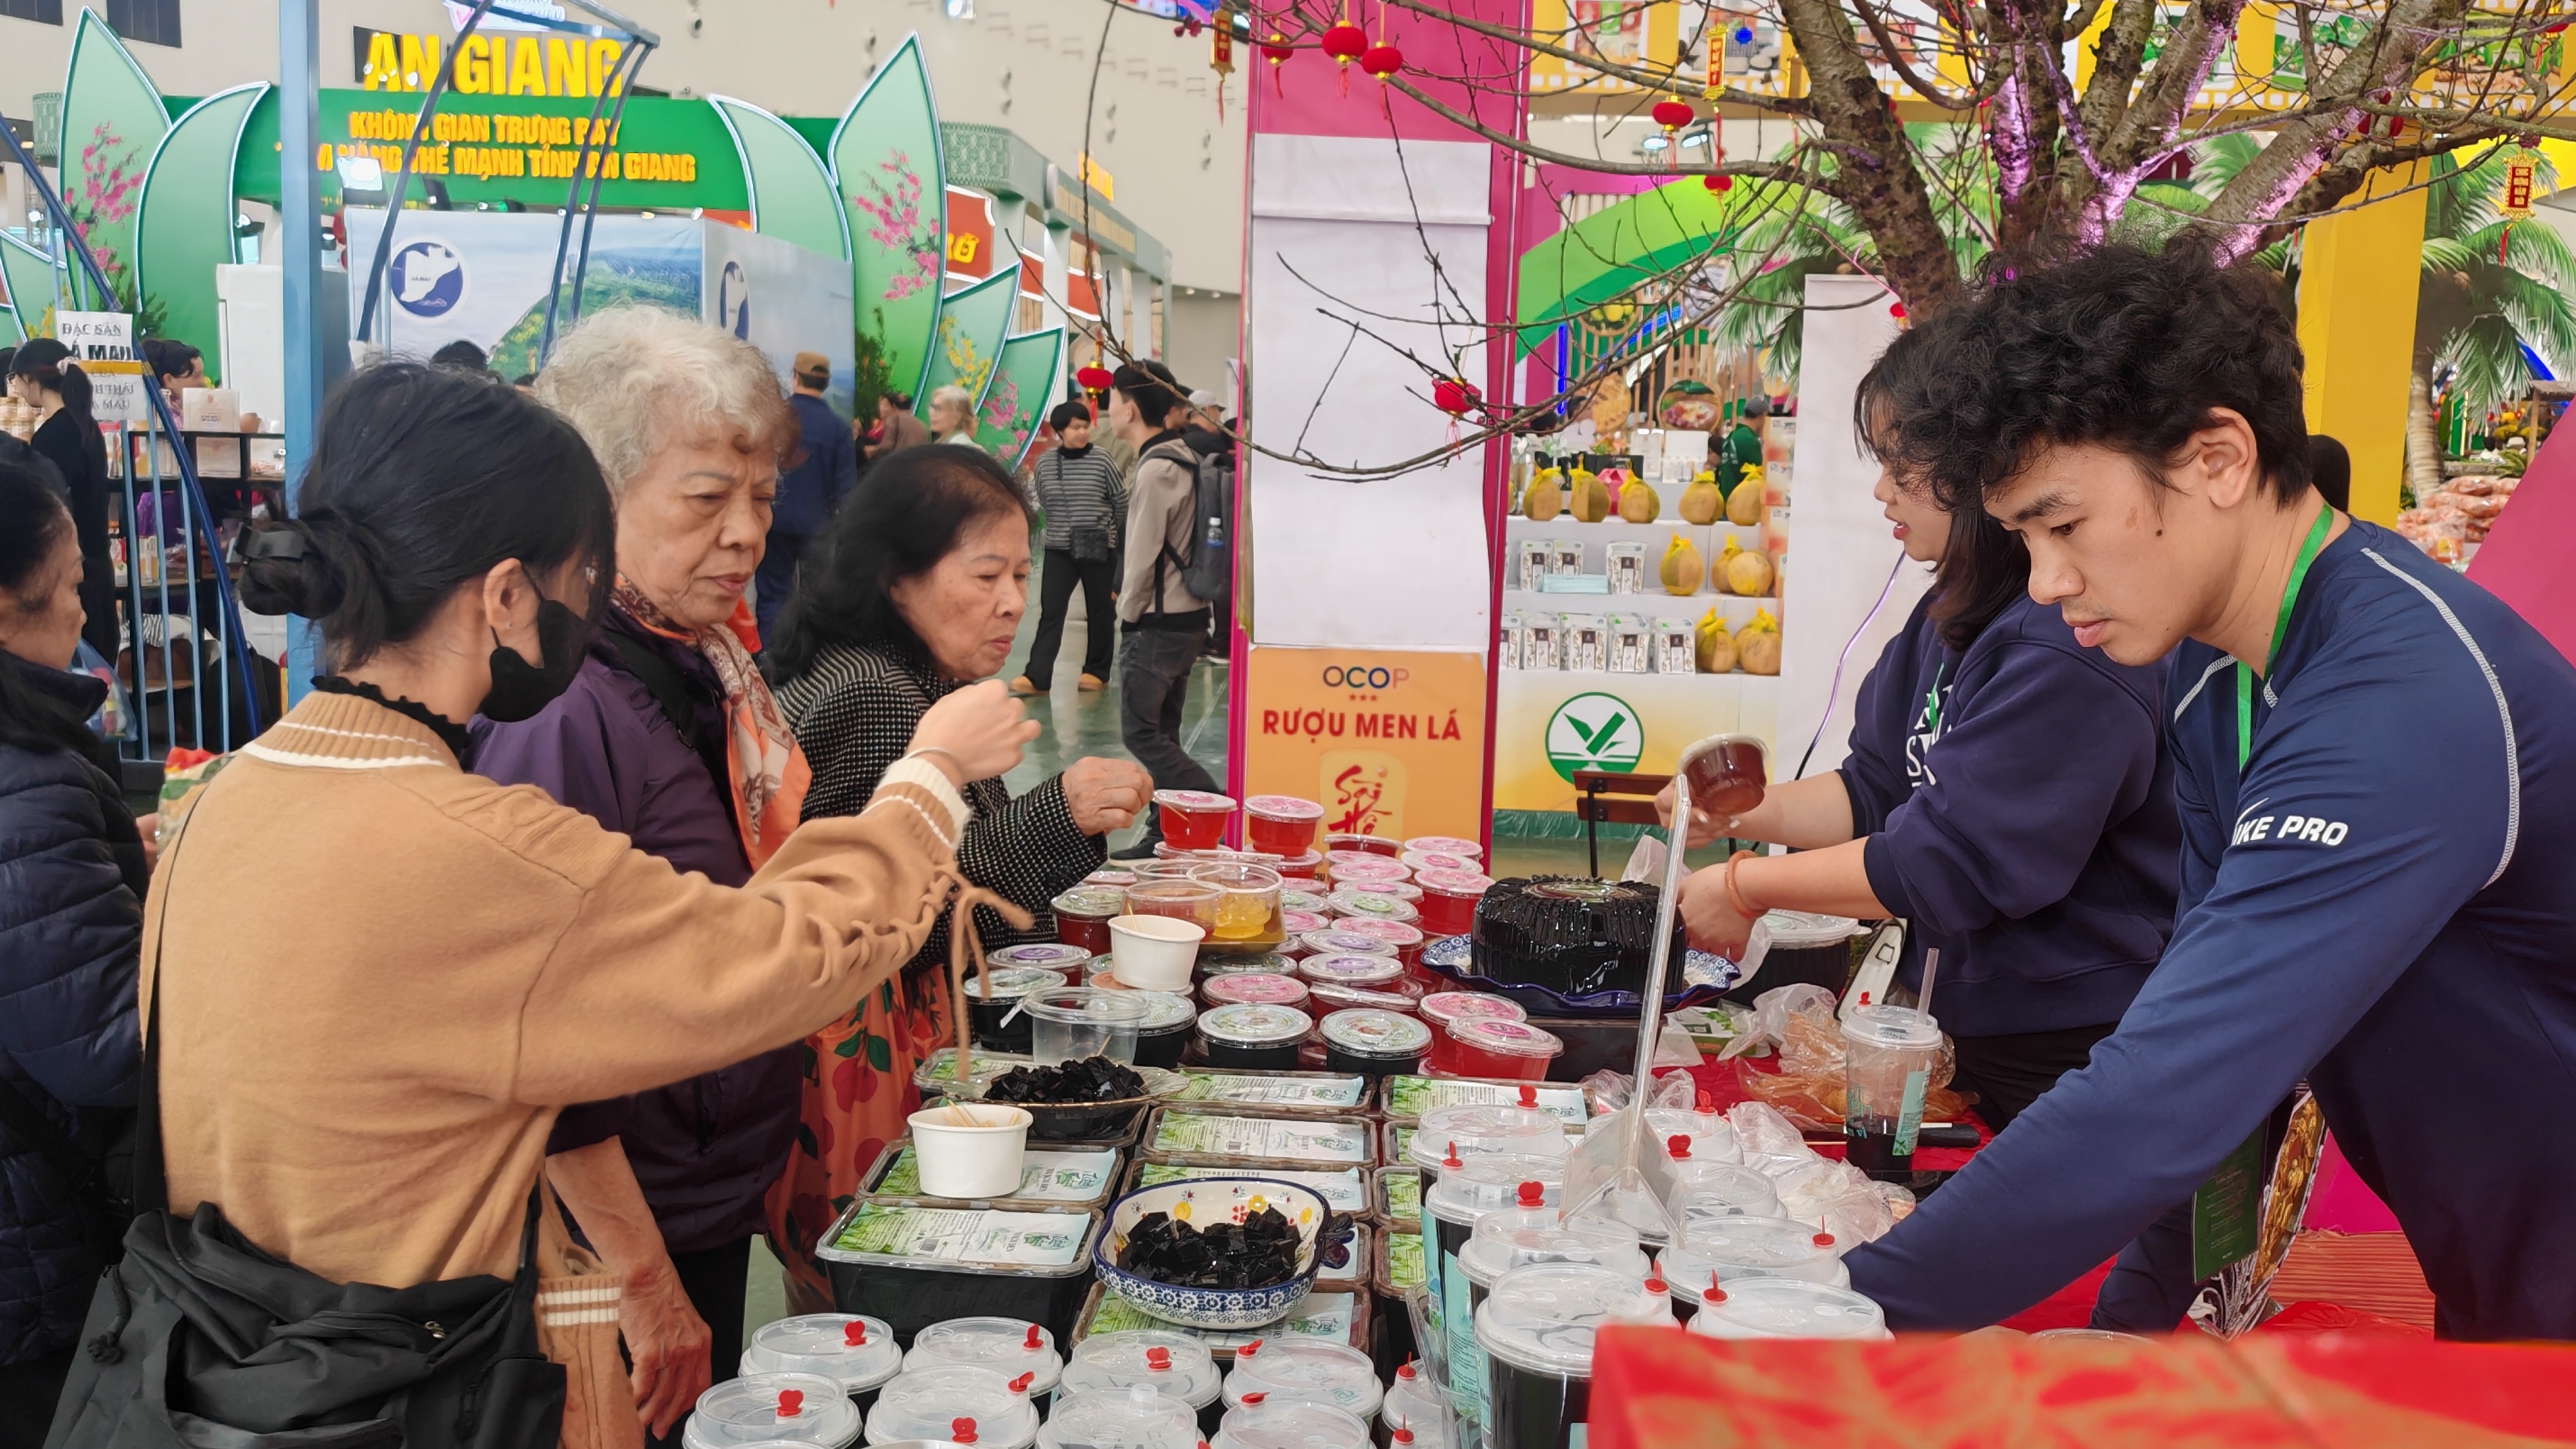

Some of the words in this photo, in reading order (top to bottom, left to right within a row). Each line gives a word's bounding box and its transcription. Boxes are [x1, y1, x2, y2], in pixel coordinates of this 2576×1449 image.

[364, 33, 439, 92] AN
[453, 35, 622, 97] GIANG
[432, 113, 490, 143] GIAN
[493, 113, 571, 144] TRƯNG
[453, 147, 524, 180] MẠNH
[623, 152, 696, 182] GIANG
[1323, 665, 1410, 689] OCOP
[1263, 707, 1346, 744] RƯỢU
[1355, 713, 1417, 740] MEN
[1427, 708, 1461, 741] LÁ
[2277, 815, 2349, 847] PRO
